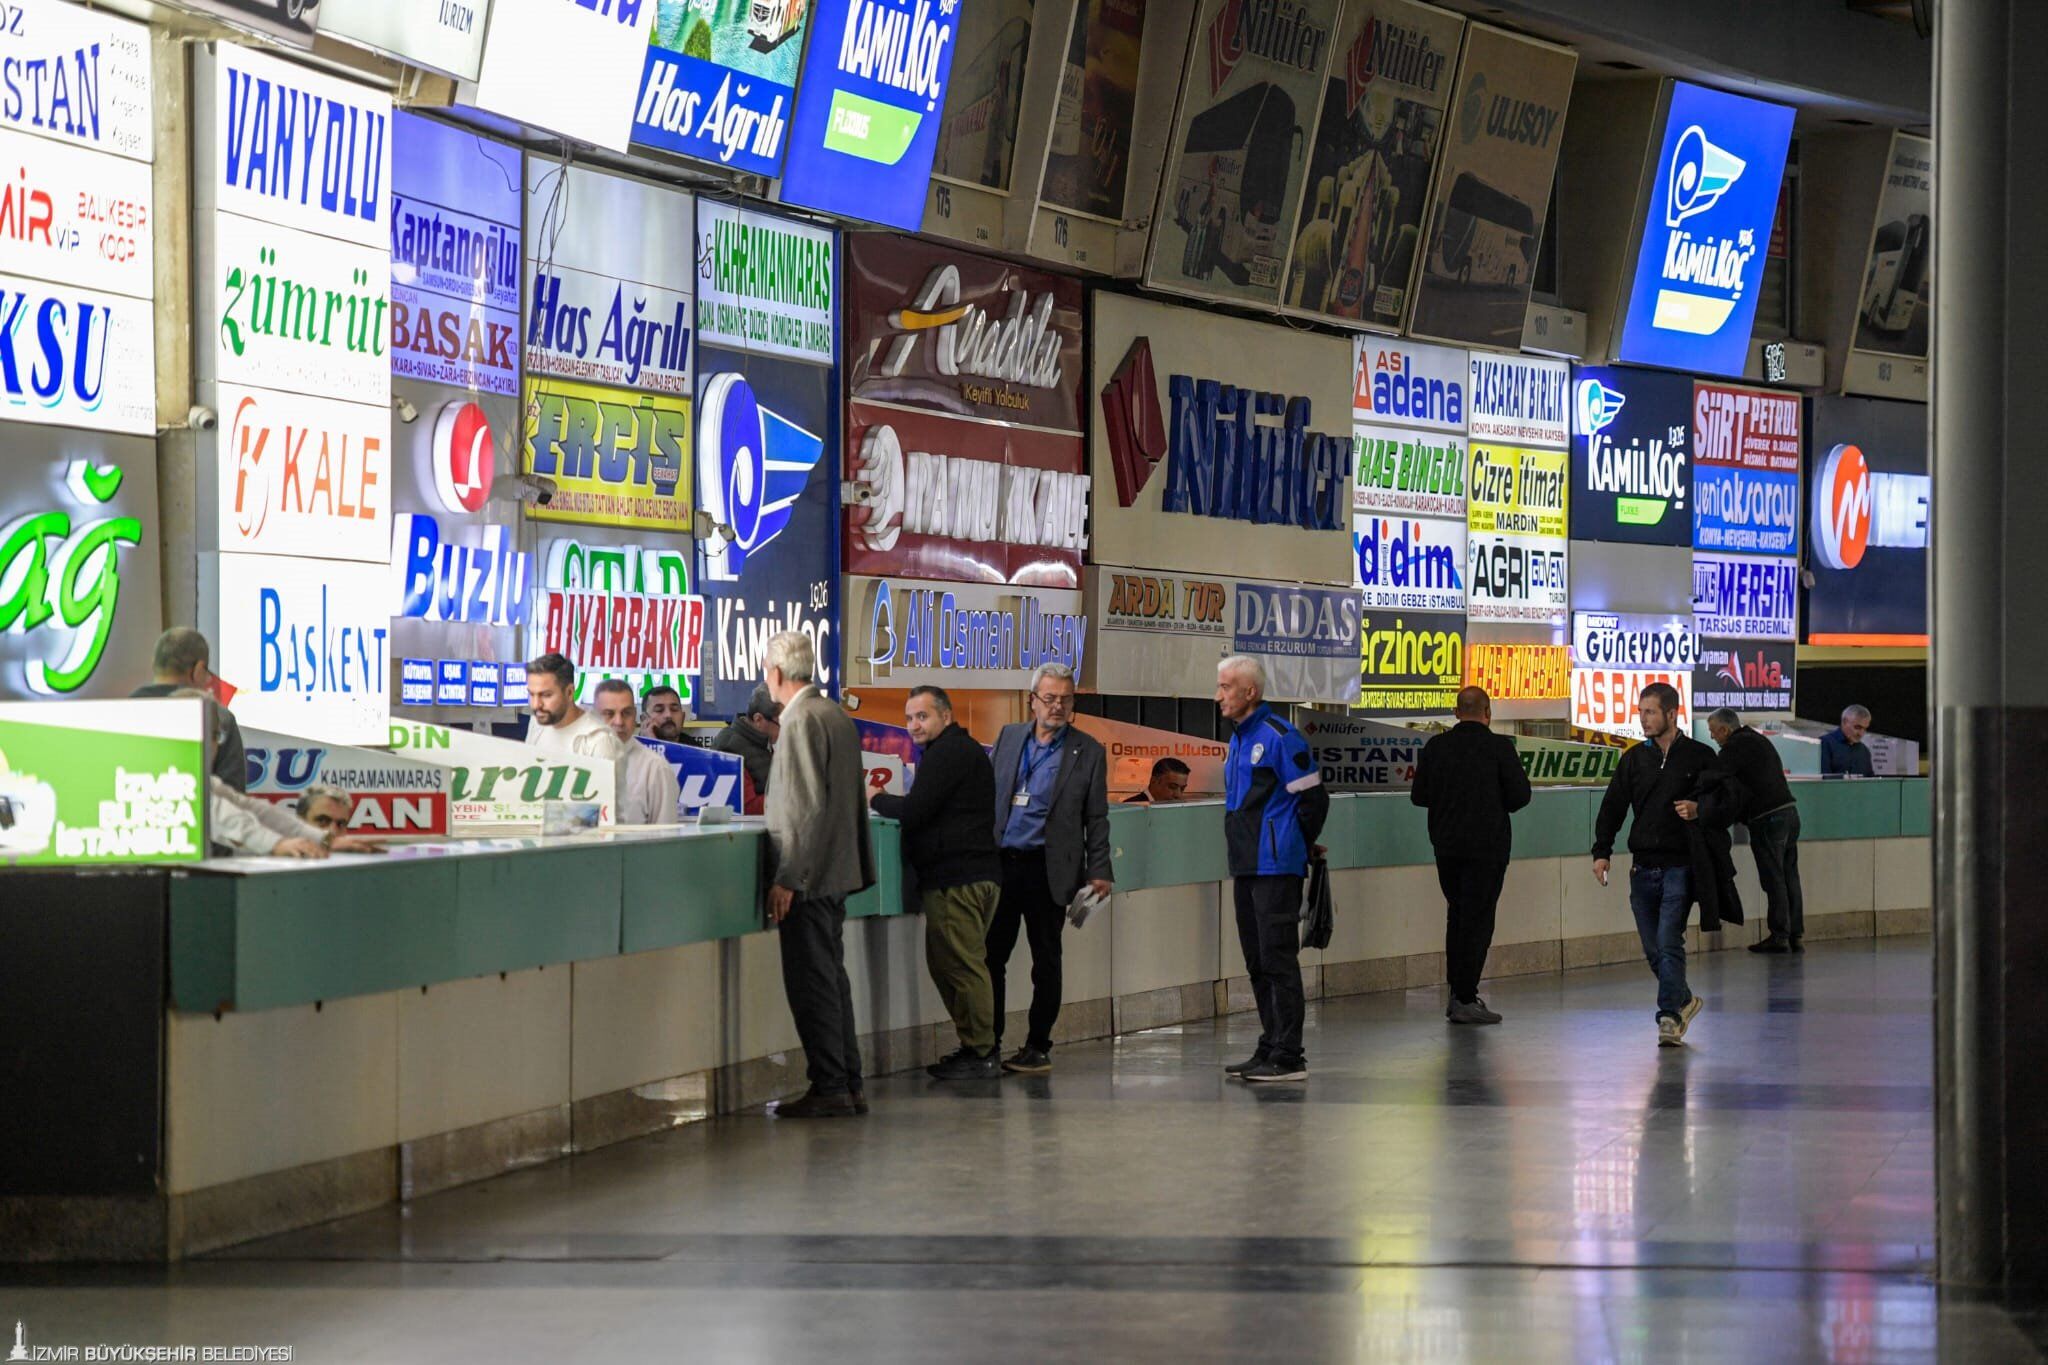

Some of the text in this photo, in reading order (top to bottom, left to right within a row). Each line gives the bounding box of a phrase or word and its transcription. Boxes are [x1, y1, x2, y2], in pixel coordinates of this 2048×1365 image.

[1364, 18, 1445, 93] Nilüfer
[636, 59, 784, 162] Has Ağrılı
[1486, 95, 1560, 148] ULUSOY
[226, 67, 385, 223] VANYOLU
[936, 185, 950, 219] 175
[1054, 215, 1068, 249] 176
[714, 218, 830, 319] KAHRAMANMARAŞ
[527, 272, 691, 384] Has Ağrılı
[880, 264, 1063, 389] Anadolu
[1376, 350, 1402, 373] AS
[1373, 356, 1462, 424] adana
[1474, 360, 1527, 419] AKSARAY
[1750, 396, 1798, 437] PETROL
[281, 425, 382, 521] KALE
[1162, 373, 1354, 531] Nilüfer
[1358, 438, 1465, 497] HAS BİNGÖL
[1471, 450, 1514, 505] Cizre
[907, 452, 1091, 550] PAMUKKALE
[1694, 477, 1721, 529] yeni
[399, 513, 534, 626] Buzlu
[1360, 517, 1454, 589] didim
[1472, 538, 1529, 599] AĞRI
[809, 580, 828, 611] 1926
[1108, 575, 1226, 622] ARDA TUR
[1401, 593, 1427, 608] GEBZE
[1694, 566, 1716, 604] LÜKS
[1717, 559, 1796, 619] MERSİN
[903, 590, 1088, 684] Ali Osman Ulusoy
[1237, 590, 1356, 646] DADAŞ
[1586, 624, 1703, 664] GÜNEYDOĞU
[1700, 617, 1742, 633] TARSUS
[1267, 640, 1317, 655] ERZURUM
[1112, 743, 1228, 762] Osman Ulusoy
[1319, 722, 1366, 735] Nilüfer
[1360, 737, 1424, 746] BURSA
[320, 769, 443, 793] KAHRAMANMARAŞ
[350, 798, 434, 831] AN
